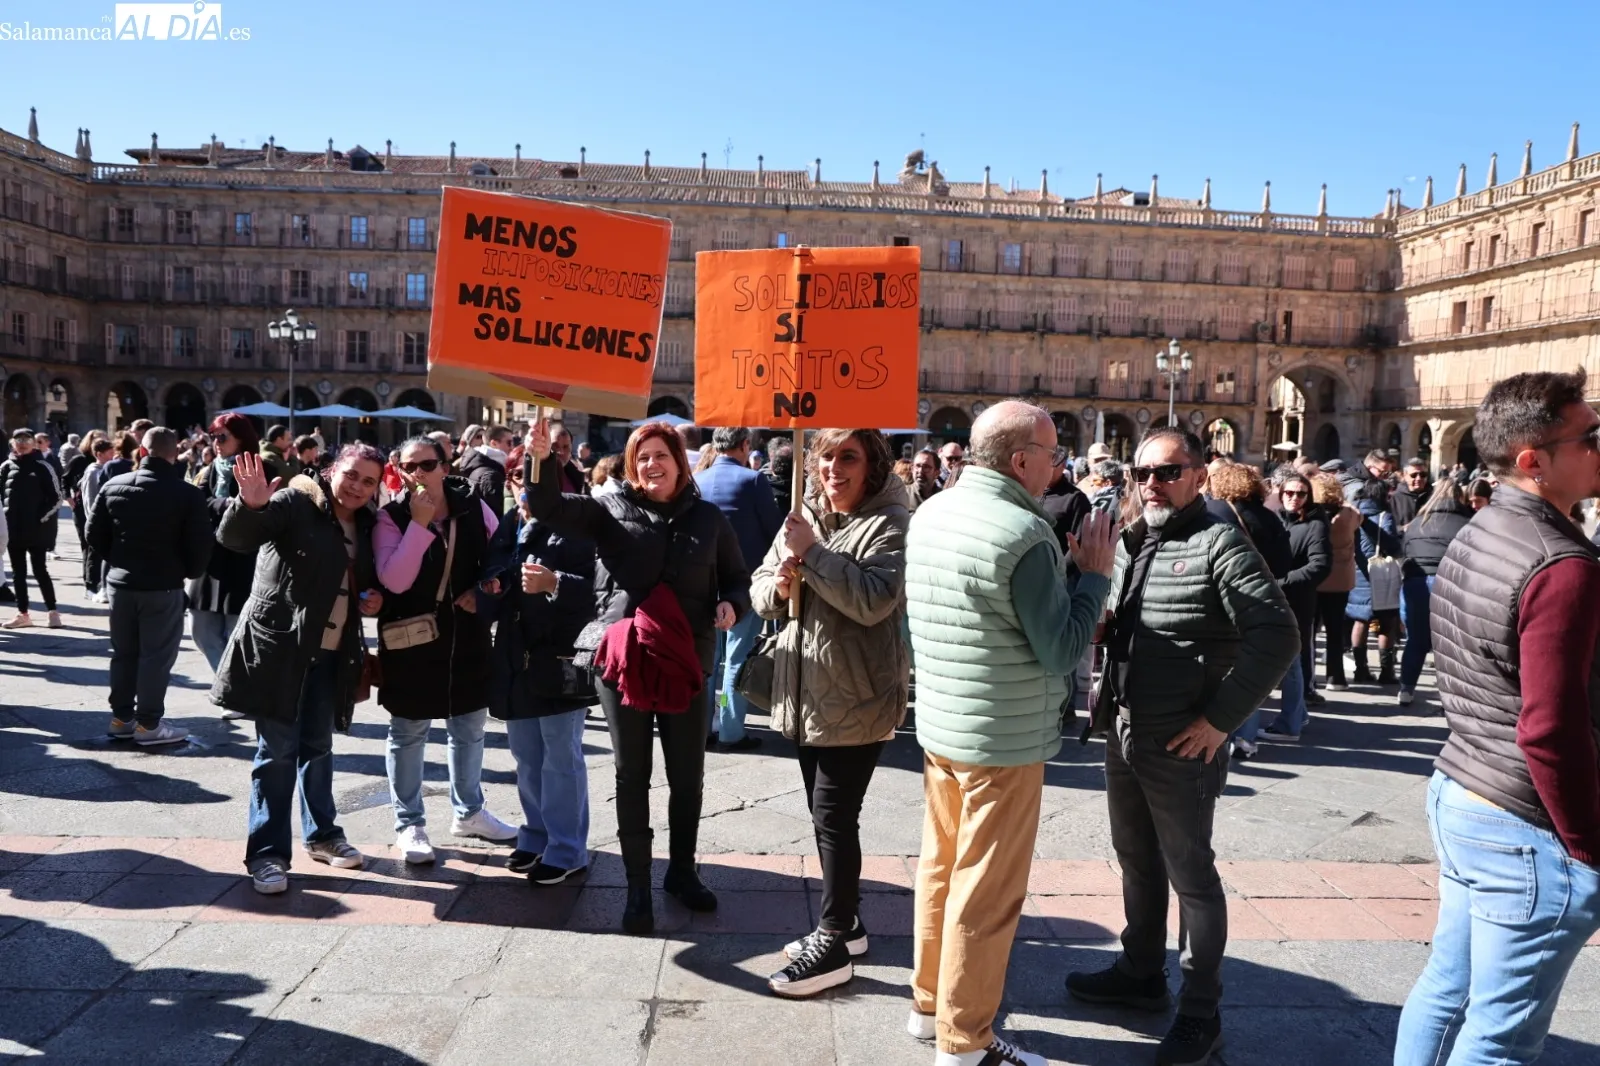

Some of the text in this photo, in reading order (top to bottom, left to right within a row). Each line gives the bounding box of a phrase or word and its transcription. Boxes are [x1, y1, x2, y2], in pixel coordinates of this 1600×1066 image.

[464, 212, 578, 258] MENOS
[458, 281, 522, 314] MÁS
[734, 272, 918, 312] SOLIDARIOS
[474, 312, 654, 363] SOLUCIONES
[773, 310, 808, 343] SÍ
[732, 346, 889, 390] TONTOS
[773, 391, 817, 418] NO
